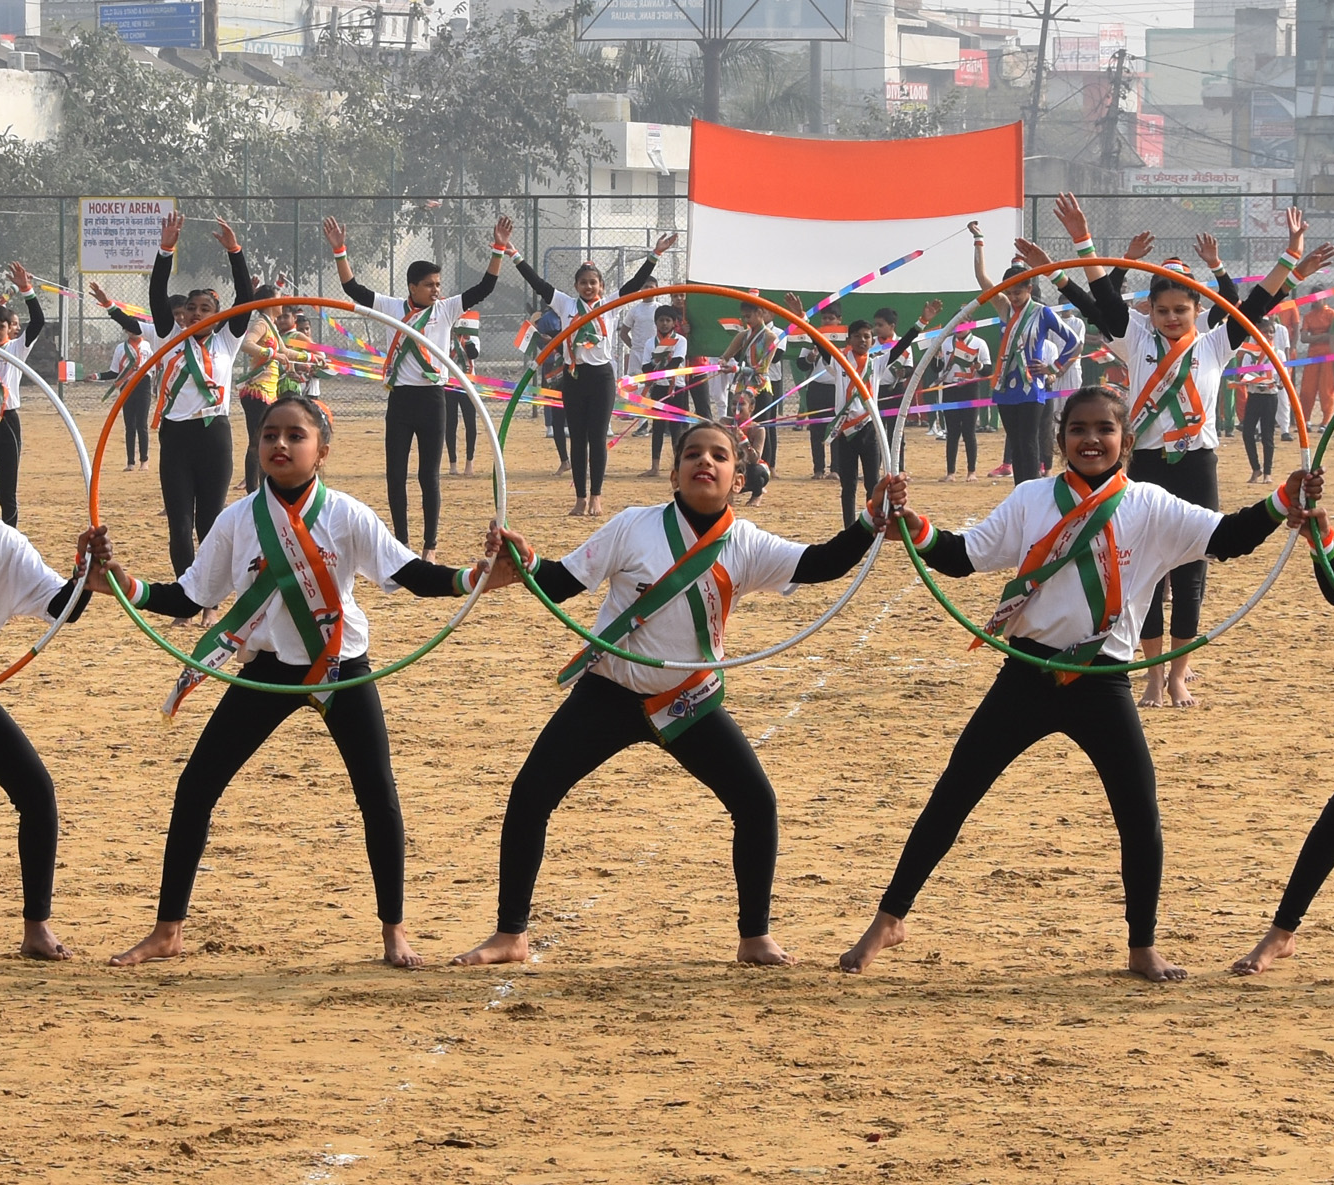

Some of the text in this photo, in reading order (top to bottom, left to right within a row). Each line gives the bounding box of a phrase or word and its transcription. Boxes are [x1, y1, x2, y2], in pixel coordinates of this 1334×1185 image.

[246, 42, 304, 59] ACADEMY
[910, 85, 928, 100] LOOK
[1135, 174, 1150, 185] न्यू
[88, 202, 161, 214] HOCKEY ARENA
[281, 526, 316, 599] JAI HIND
[704, 581, 721, 648] JAI HIND
